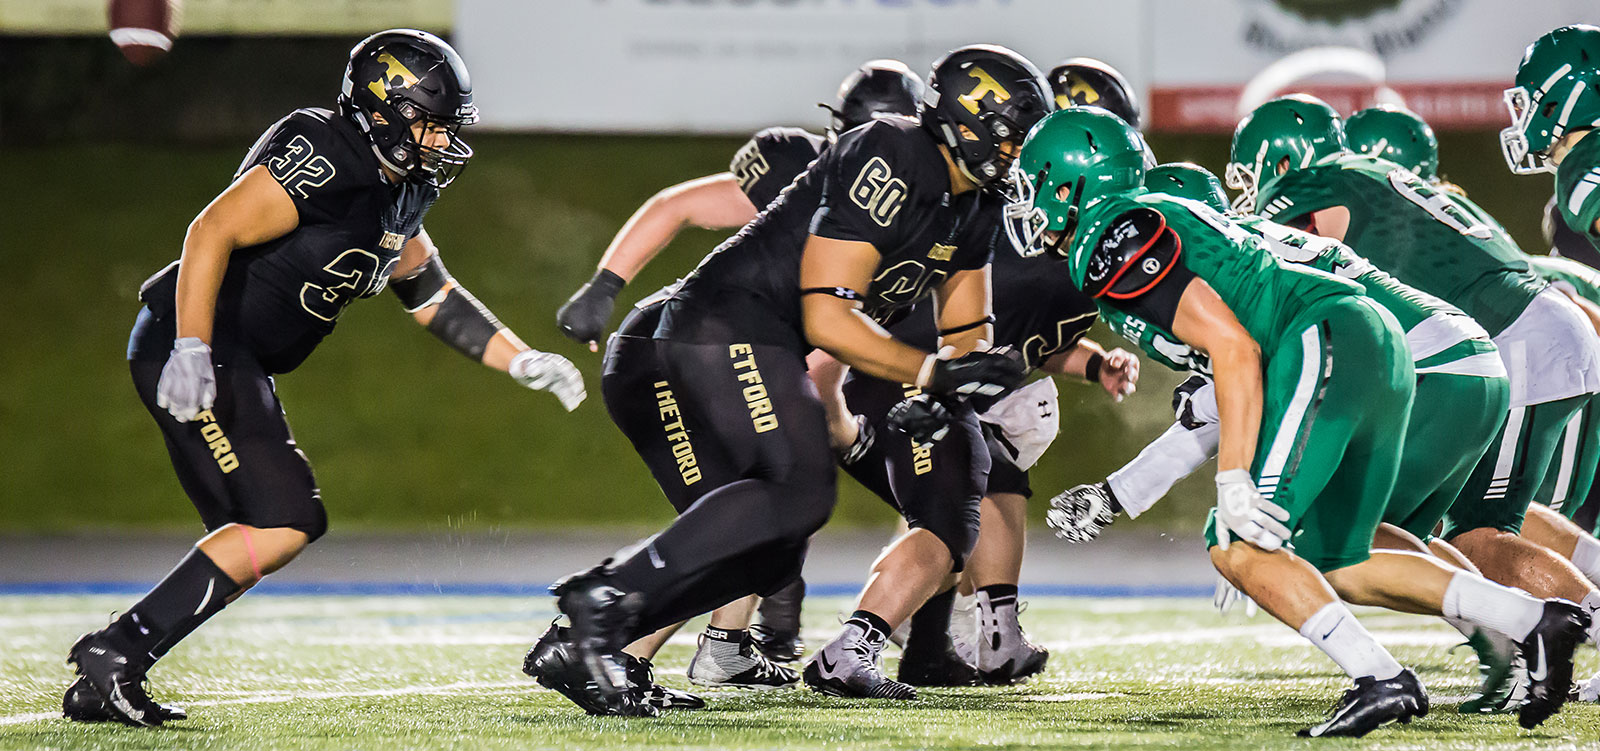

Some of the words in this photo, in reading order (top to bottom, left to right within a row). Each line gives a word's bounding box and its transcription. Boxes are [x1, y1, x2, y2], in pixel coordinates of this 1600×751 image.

[957, 66, 1012, 115] T
[268, 134, 336, 199] 32
[848, 156, 908, 228] 60
[729, 343, 779, 434] ETFORD
[193, 409, 240, 474] FORD
